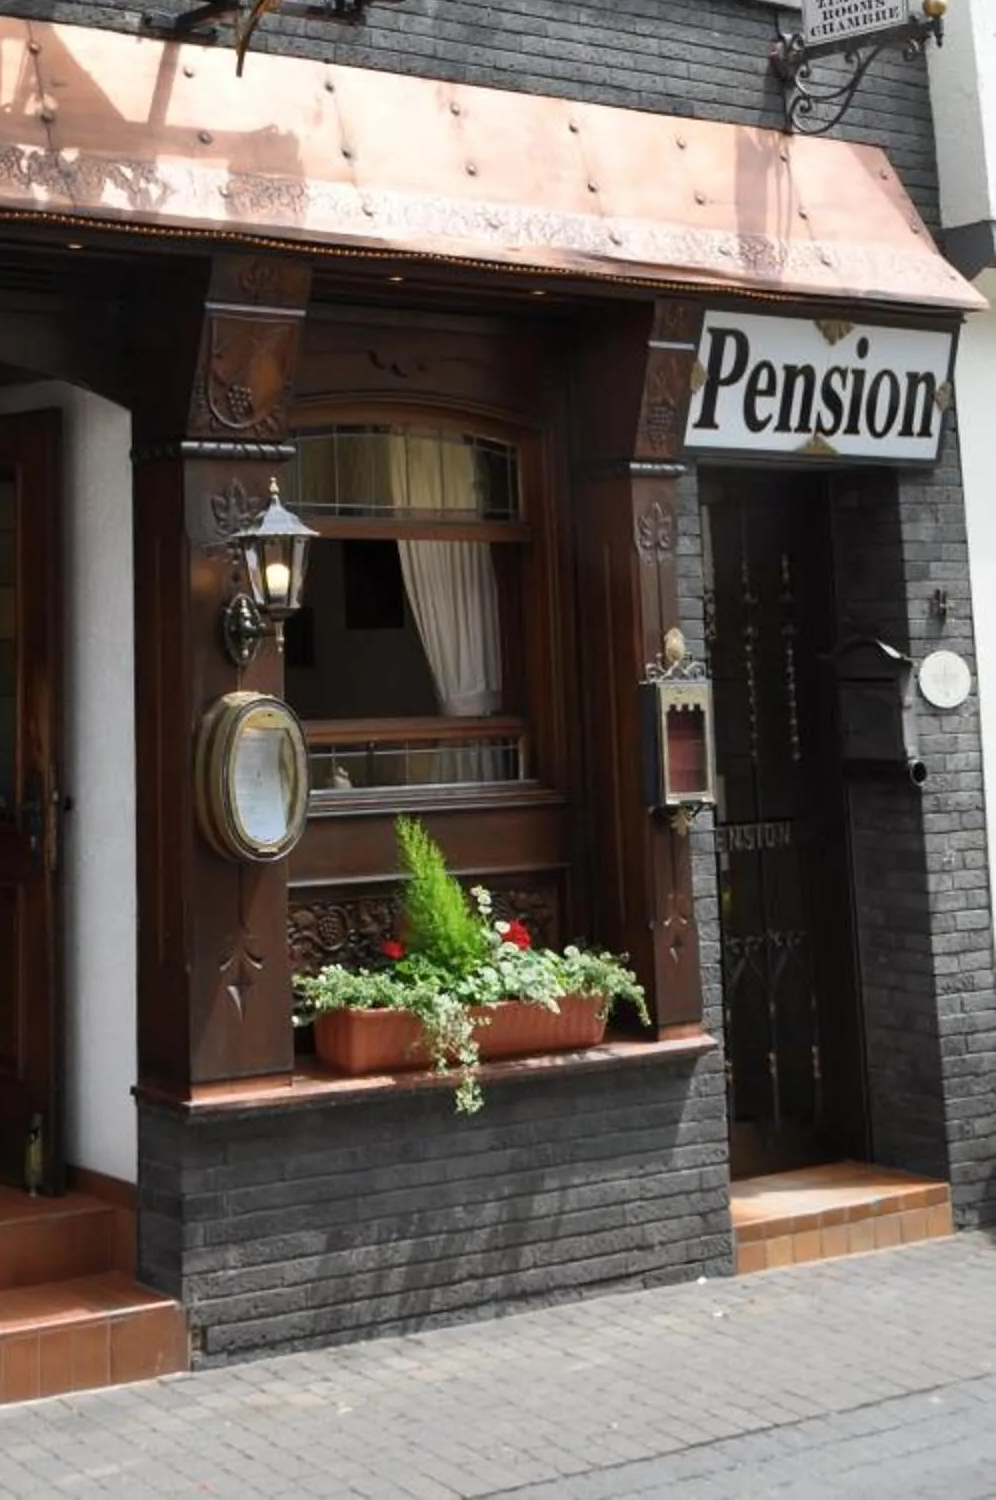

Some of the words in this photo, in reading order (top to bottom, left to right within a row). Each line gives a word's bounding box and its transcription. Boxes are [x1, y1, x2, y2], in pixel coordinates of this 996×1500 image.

[811, 6, 900, 36] CHAMBRE
[693, 327, 937, 439] Pension
[716, 821, 791, 852] ENSION
